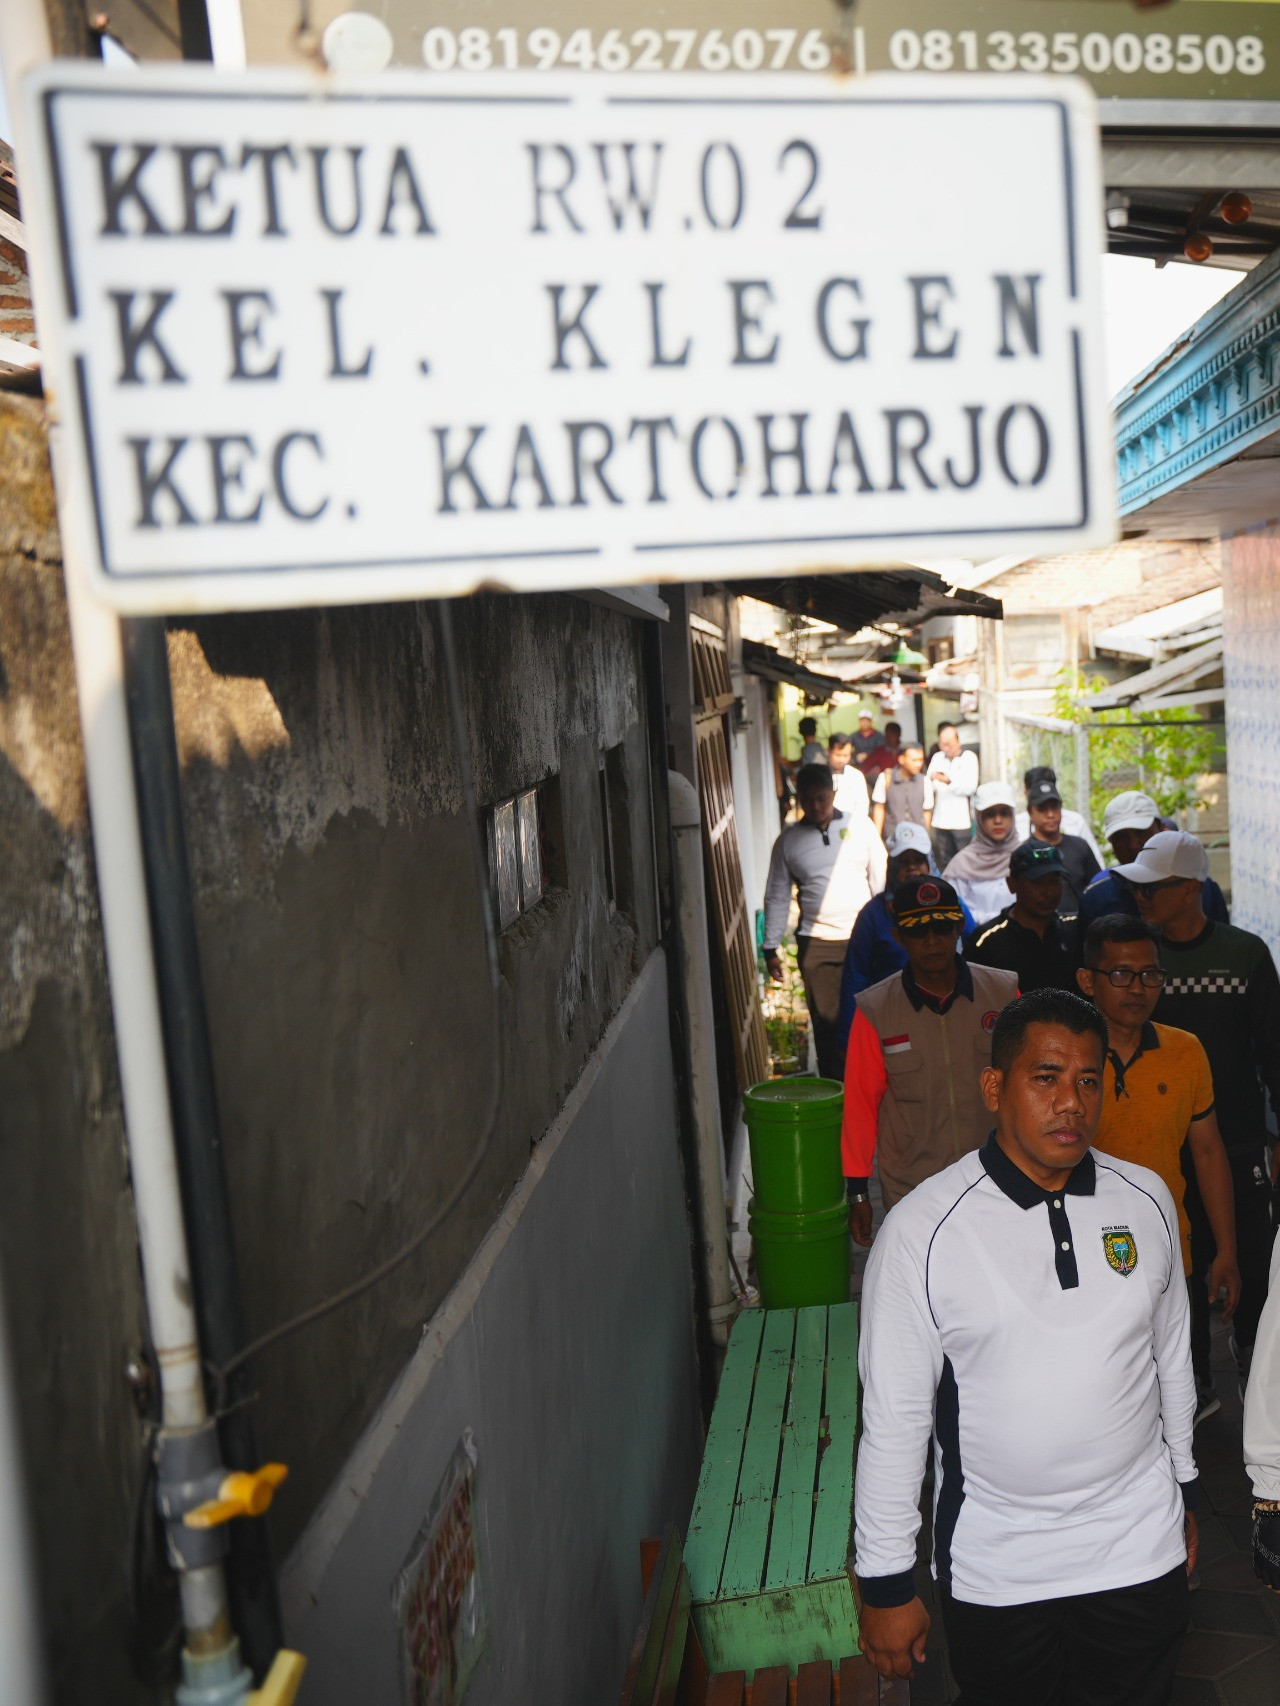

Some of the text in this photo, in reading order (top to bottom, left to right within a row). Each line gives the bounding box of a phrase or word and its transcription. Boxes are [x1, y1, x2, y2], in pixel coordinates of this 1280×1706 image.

[422, 27, 831, 72] 081946276076
[889, 29, 1267, 75] 081335008508
[87, 138, 438, 239] KETUA
[546, 272, 1046, 372] KLEGEN
[127, 401, 1052, 530] KEC. KARTOHARJO
